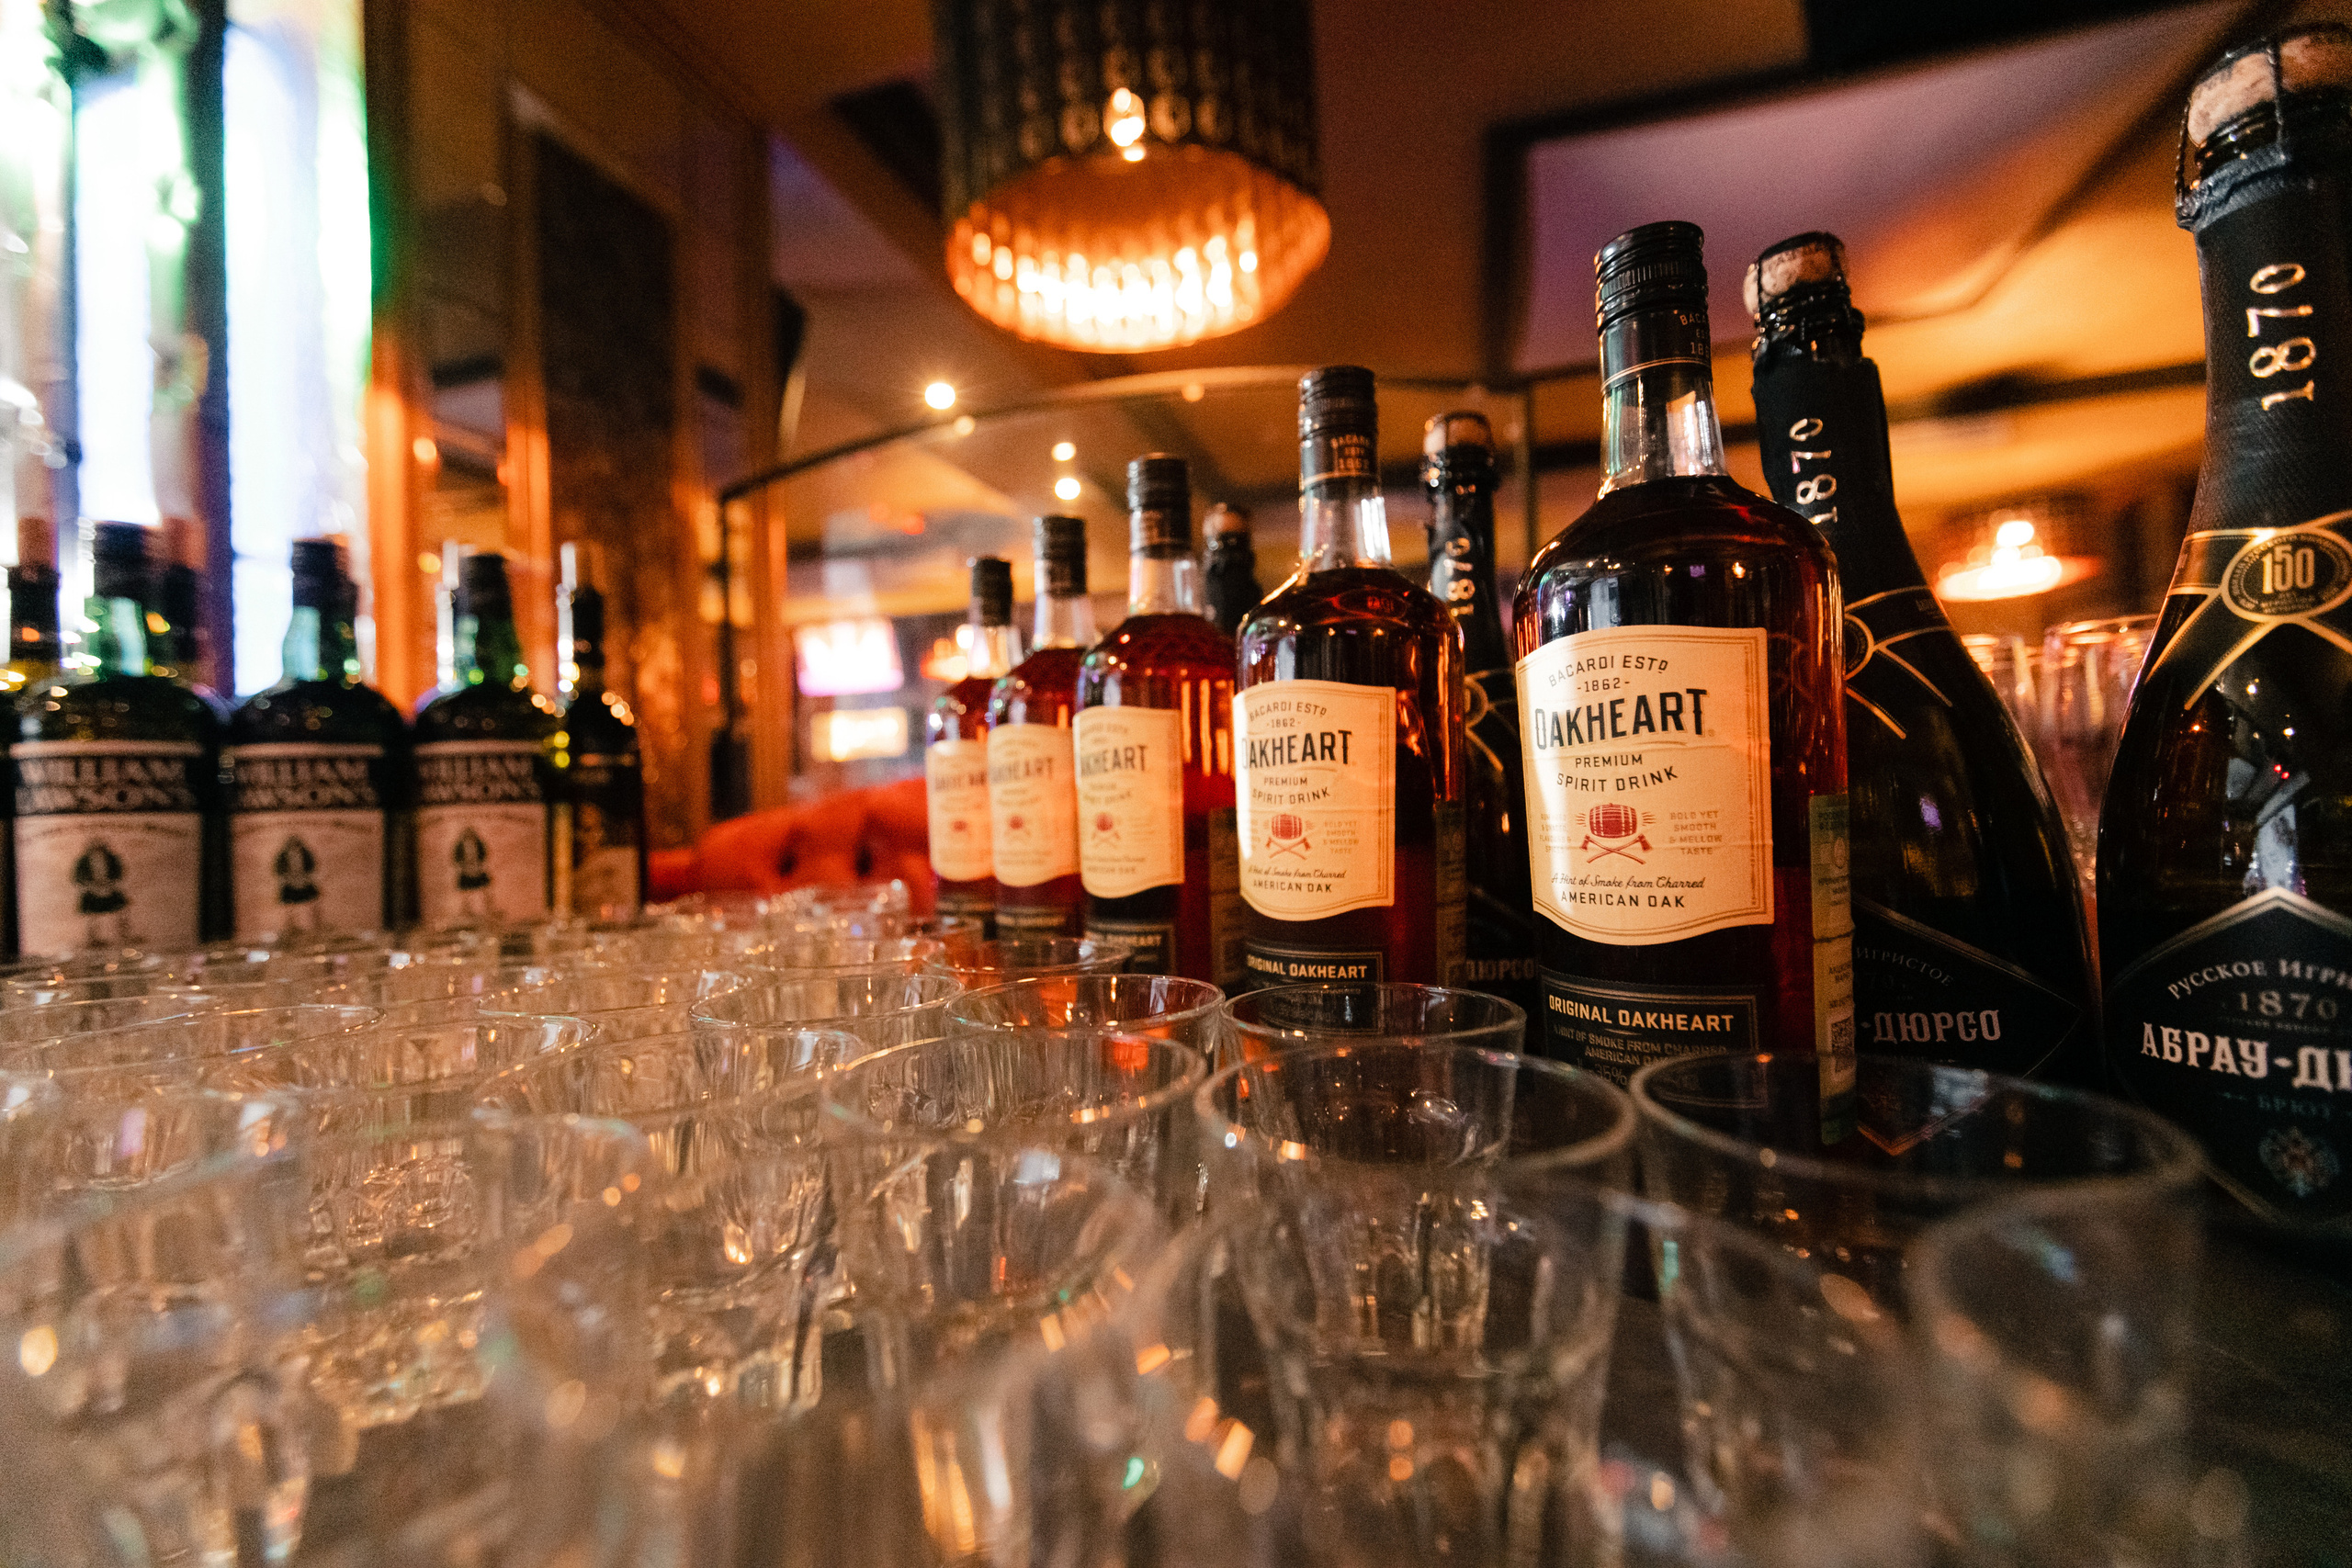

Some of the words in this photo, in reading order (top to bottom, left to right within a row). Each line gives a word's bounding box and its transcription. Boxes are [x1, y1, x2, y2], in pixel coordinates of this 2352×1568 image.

[2247, 263, 2316, 411] 1870
[1789, 418, 1838, 525] 1870
[2261, 544, 2314, 594] 150
[1548, 655, 1614, 687] BACARDI
[1250, 702, 1291, 721] BACARDI
[1534, 688, 1708, 750] OAKHEART
[1242, 729, 1352, 770] OAKHEART
[1575, 754, 1643, 768] PREMIUM
[1264, 777, 1308, 785] PREMIUM
[1557, 773, 1607, 792] SPIRIT
[1616, 766, 1679, 792] DRINK
[1252, 788, 1283, 805] SPIRIT
[1290, 787, 1330, 805] DRINK
[1700, 810, 1719, 818] YET
[1674, 823, 1716, 832] SMOOTH
[1680, 847, 1713, 855] TASTE
[1254, 880, 1302, 892] AMERICAN
[1308, 883, 1331, 893] OAK
[1578, 874, 1589, 886] of
[1590, 874, 1624, 887] Smoke
[1626, 875, 1653, 888] from
[1657, 876, 1706, 889] Charred
[1561, 891, 1639, 908] AMERICAN
[1648, 896, 1685, 908] OAK
[1289, 963, 1367, 978] OAKHEART
[2167, 960, 2267, 999] РУССКОЕ
[1548, 994, 1612, 1025] ORIGINAL
[1618, 1009, 1735, 1032] OAKHEART
[2240, 990, 2338, 1020] 1870
[1589, 1032, 1624, 1051] SMOKE
[1627, 1039, 1661, 1055] FROM
[1584, 1045, 1640, 1066] AMERICAN
